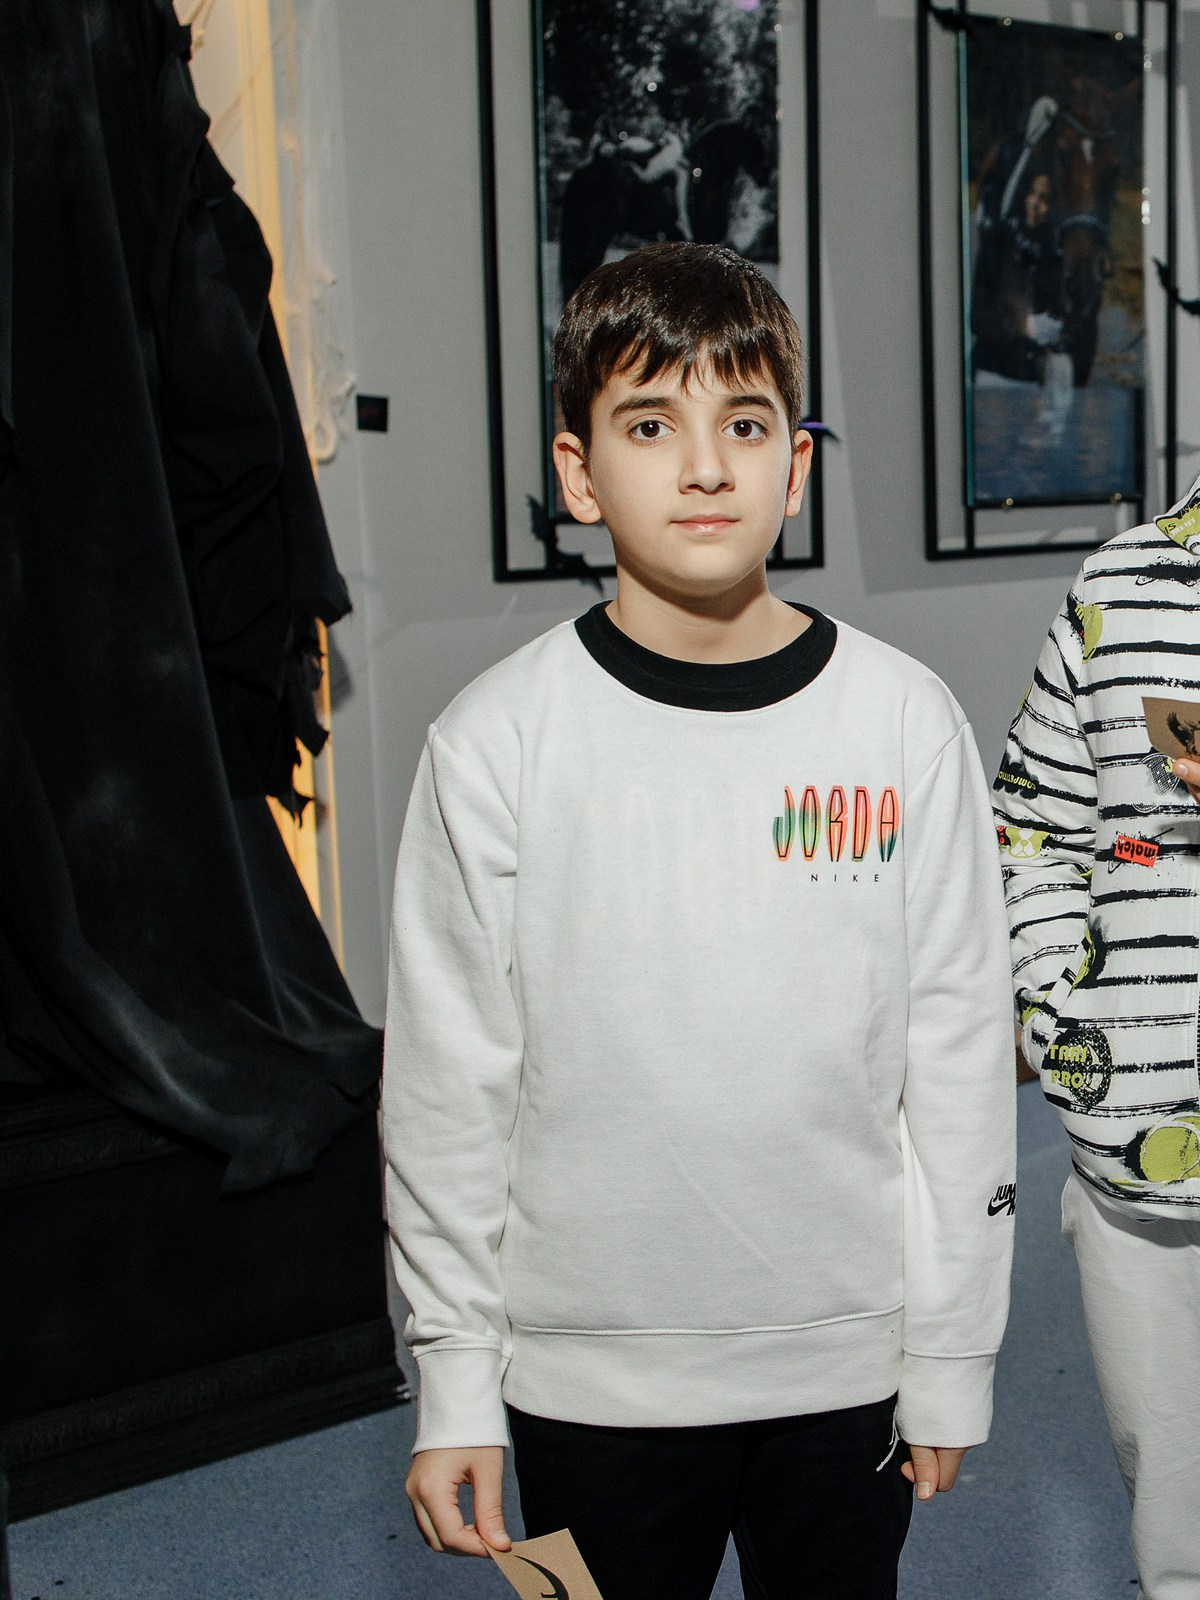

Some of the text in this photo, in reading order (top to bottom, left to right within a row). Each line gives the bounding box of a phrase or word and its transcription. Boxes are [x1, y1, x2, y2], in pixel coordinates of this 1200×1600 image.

[1117, 840, 1156, 858] match
[811, 874, 879, 882] NIKE
[1051, 1069, 1084, 1088] PRO
